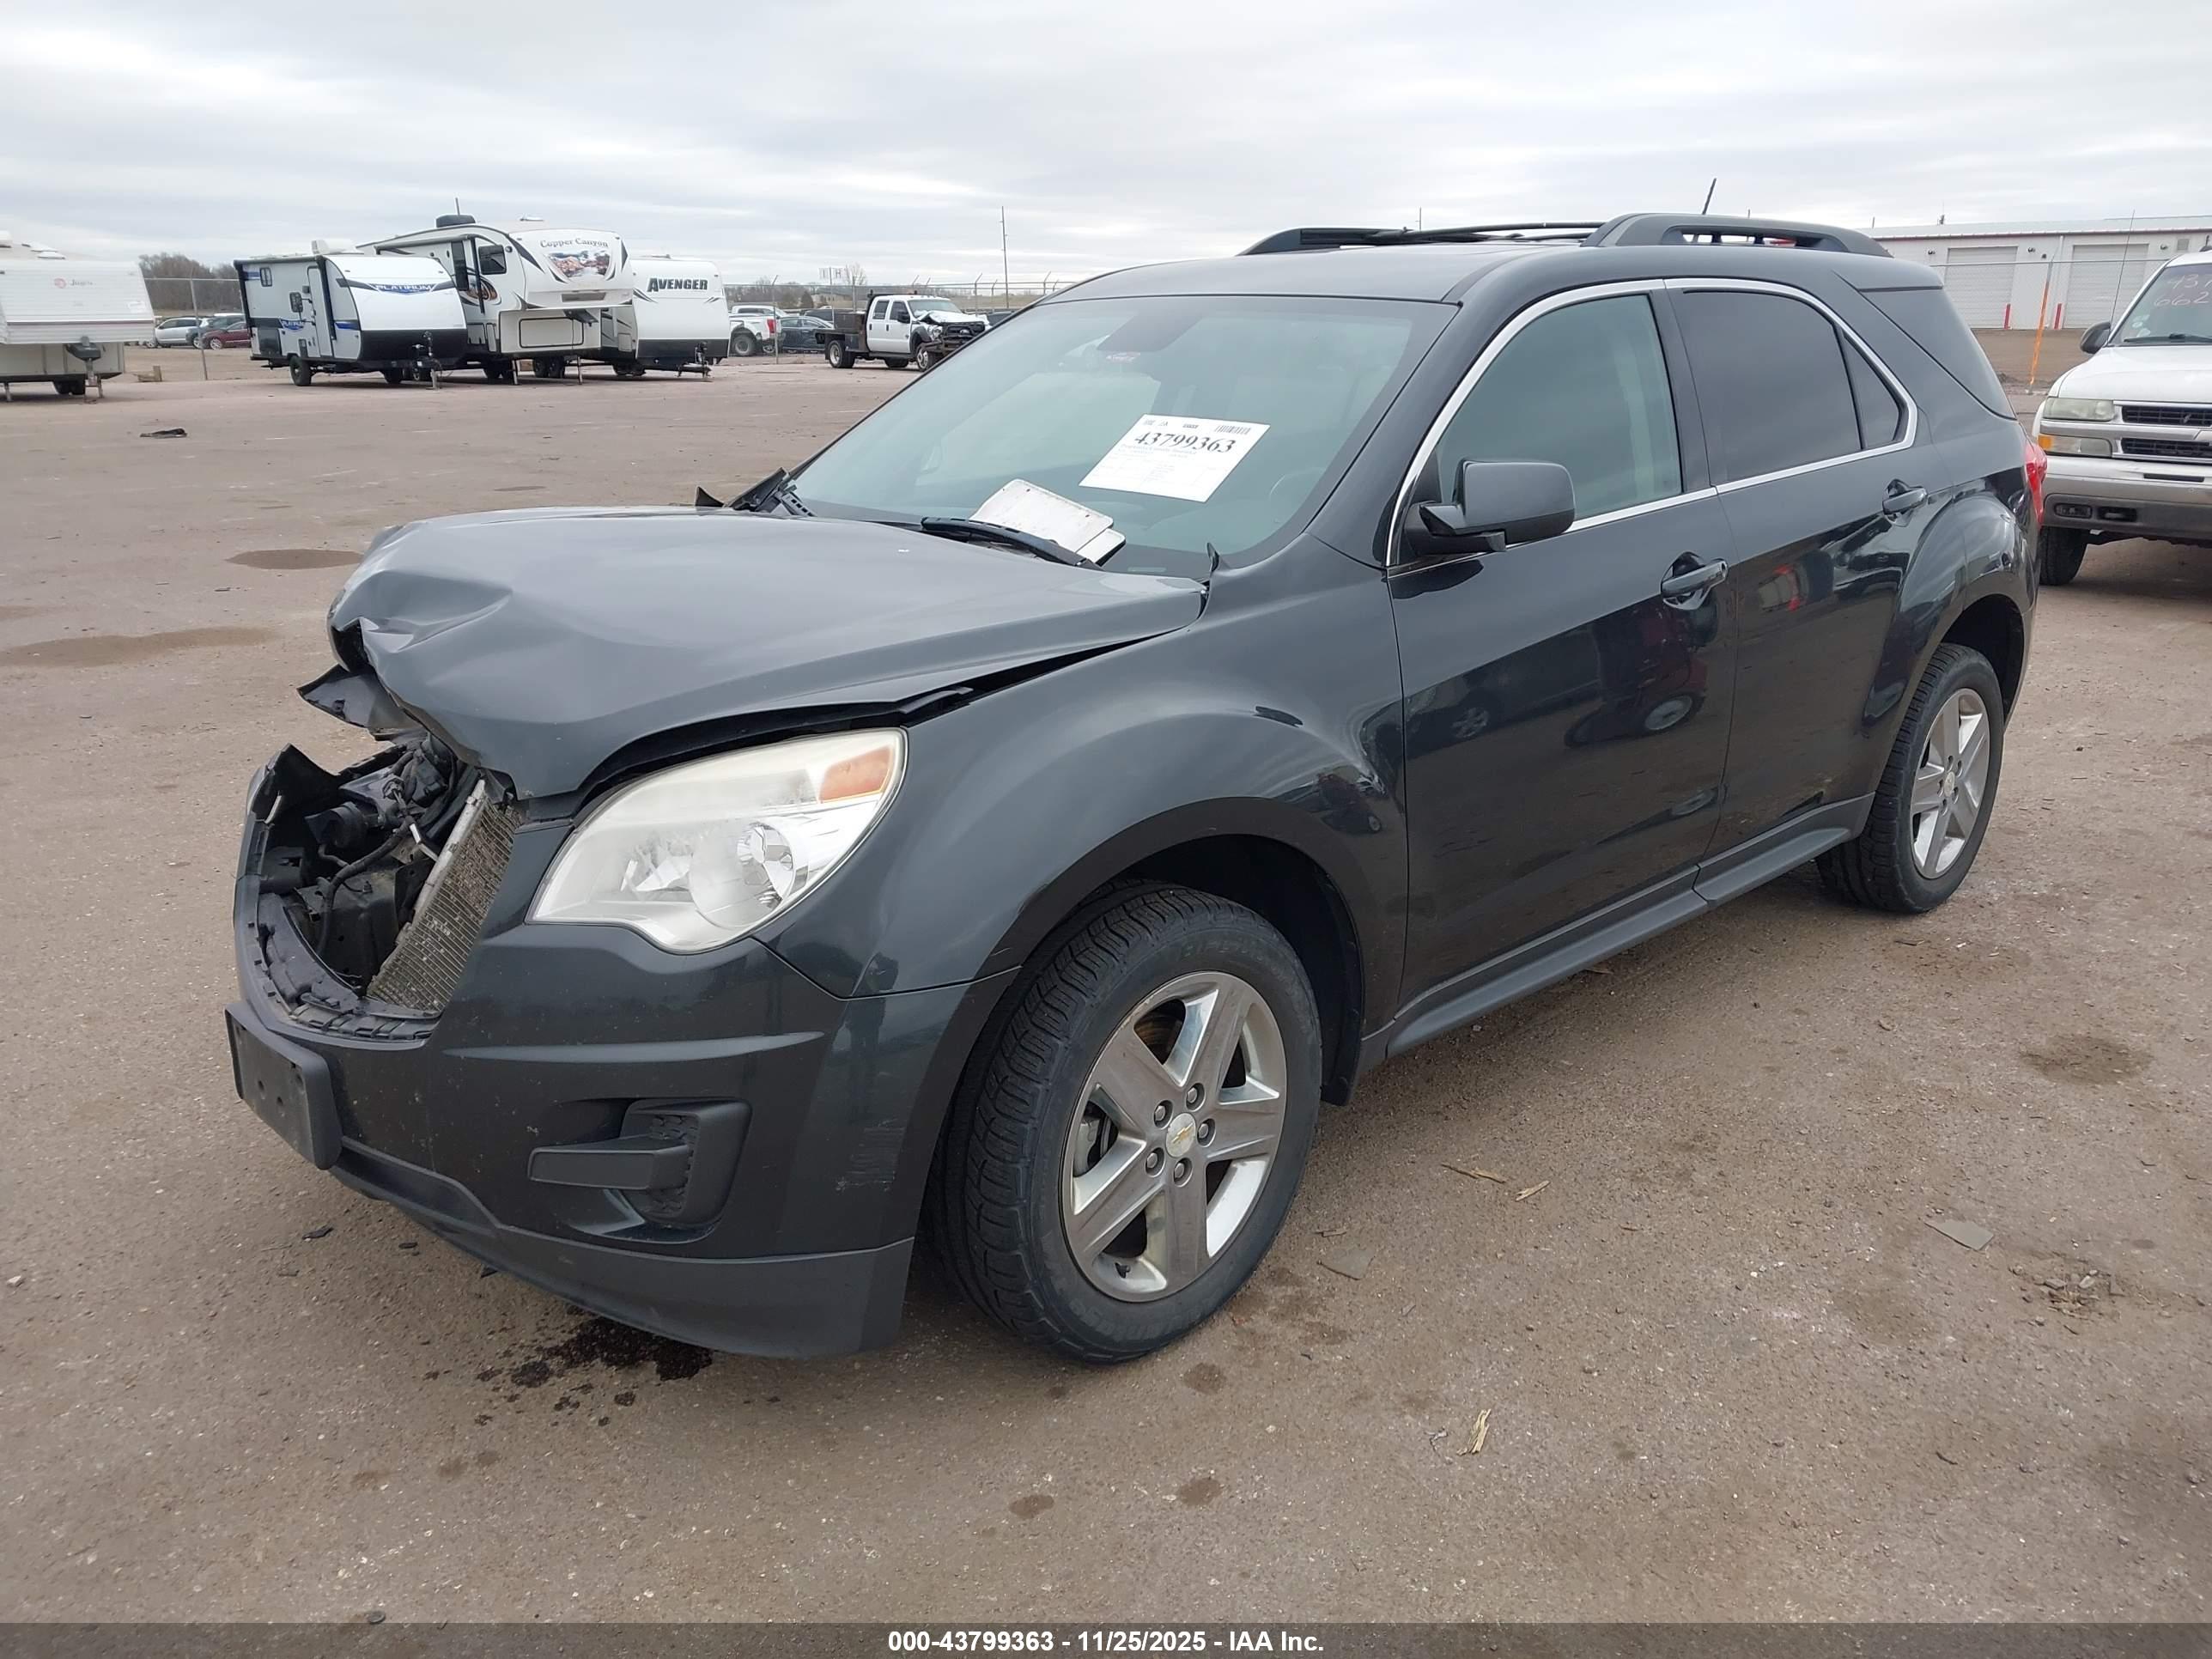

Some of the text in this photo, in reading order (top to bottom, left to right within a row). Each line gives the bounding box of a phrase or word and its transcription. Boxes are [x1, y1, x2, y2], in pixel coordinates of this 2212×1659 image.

[540, 238, 608, 248] Copper Canyon
[647, 277, 708, 292] AVENGER
[1134, 431, 1237, 453] 43799363
